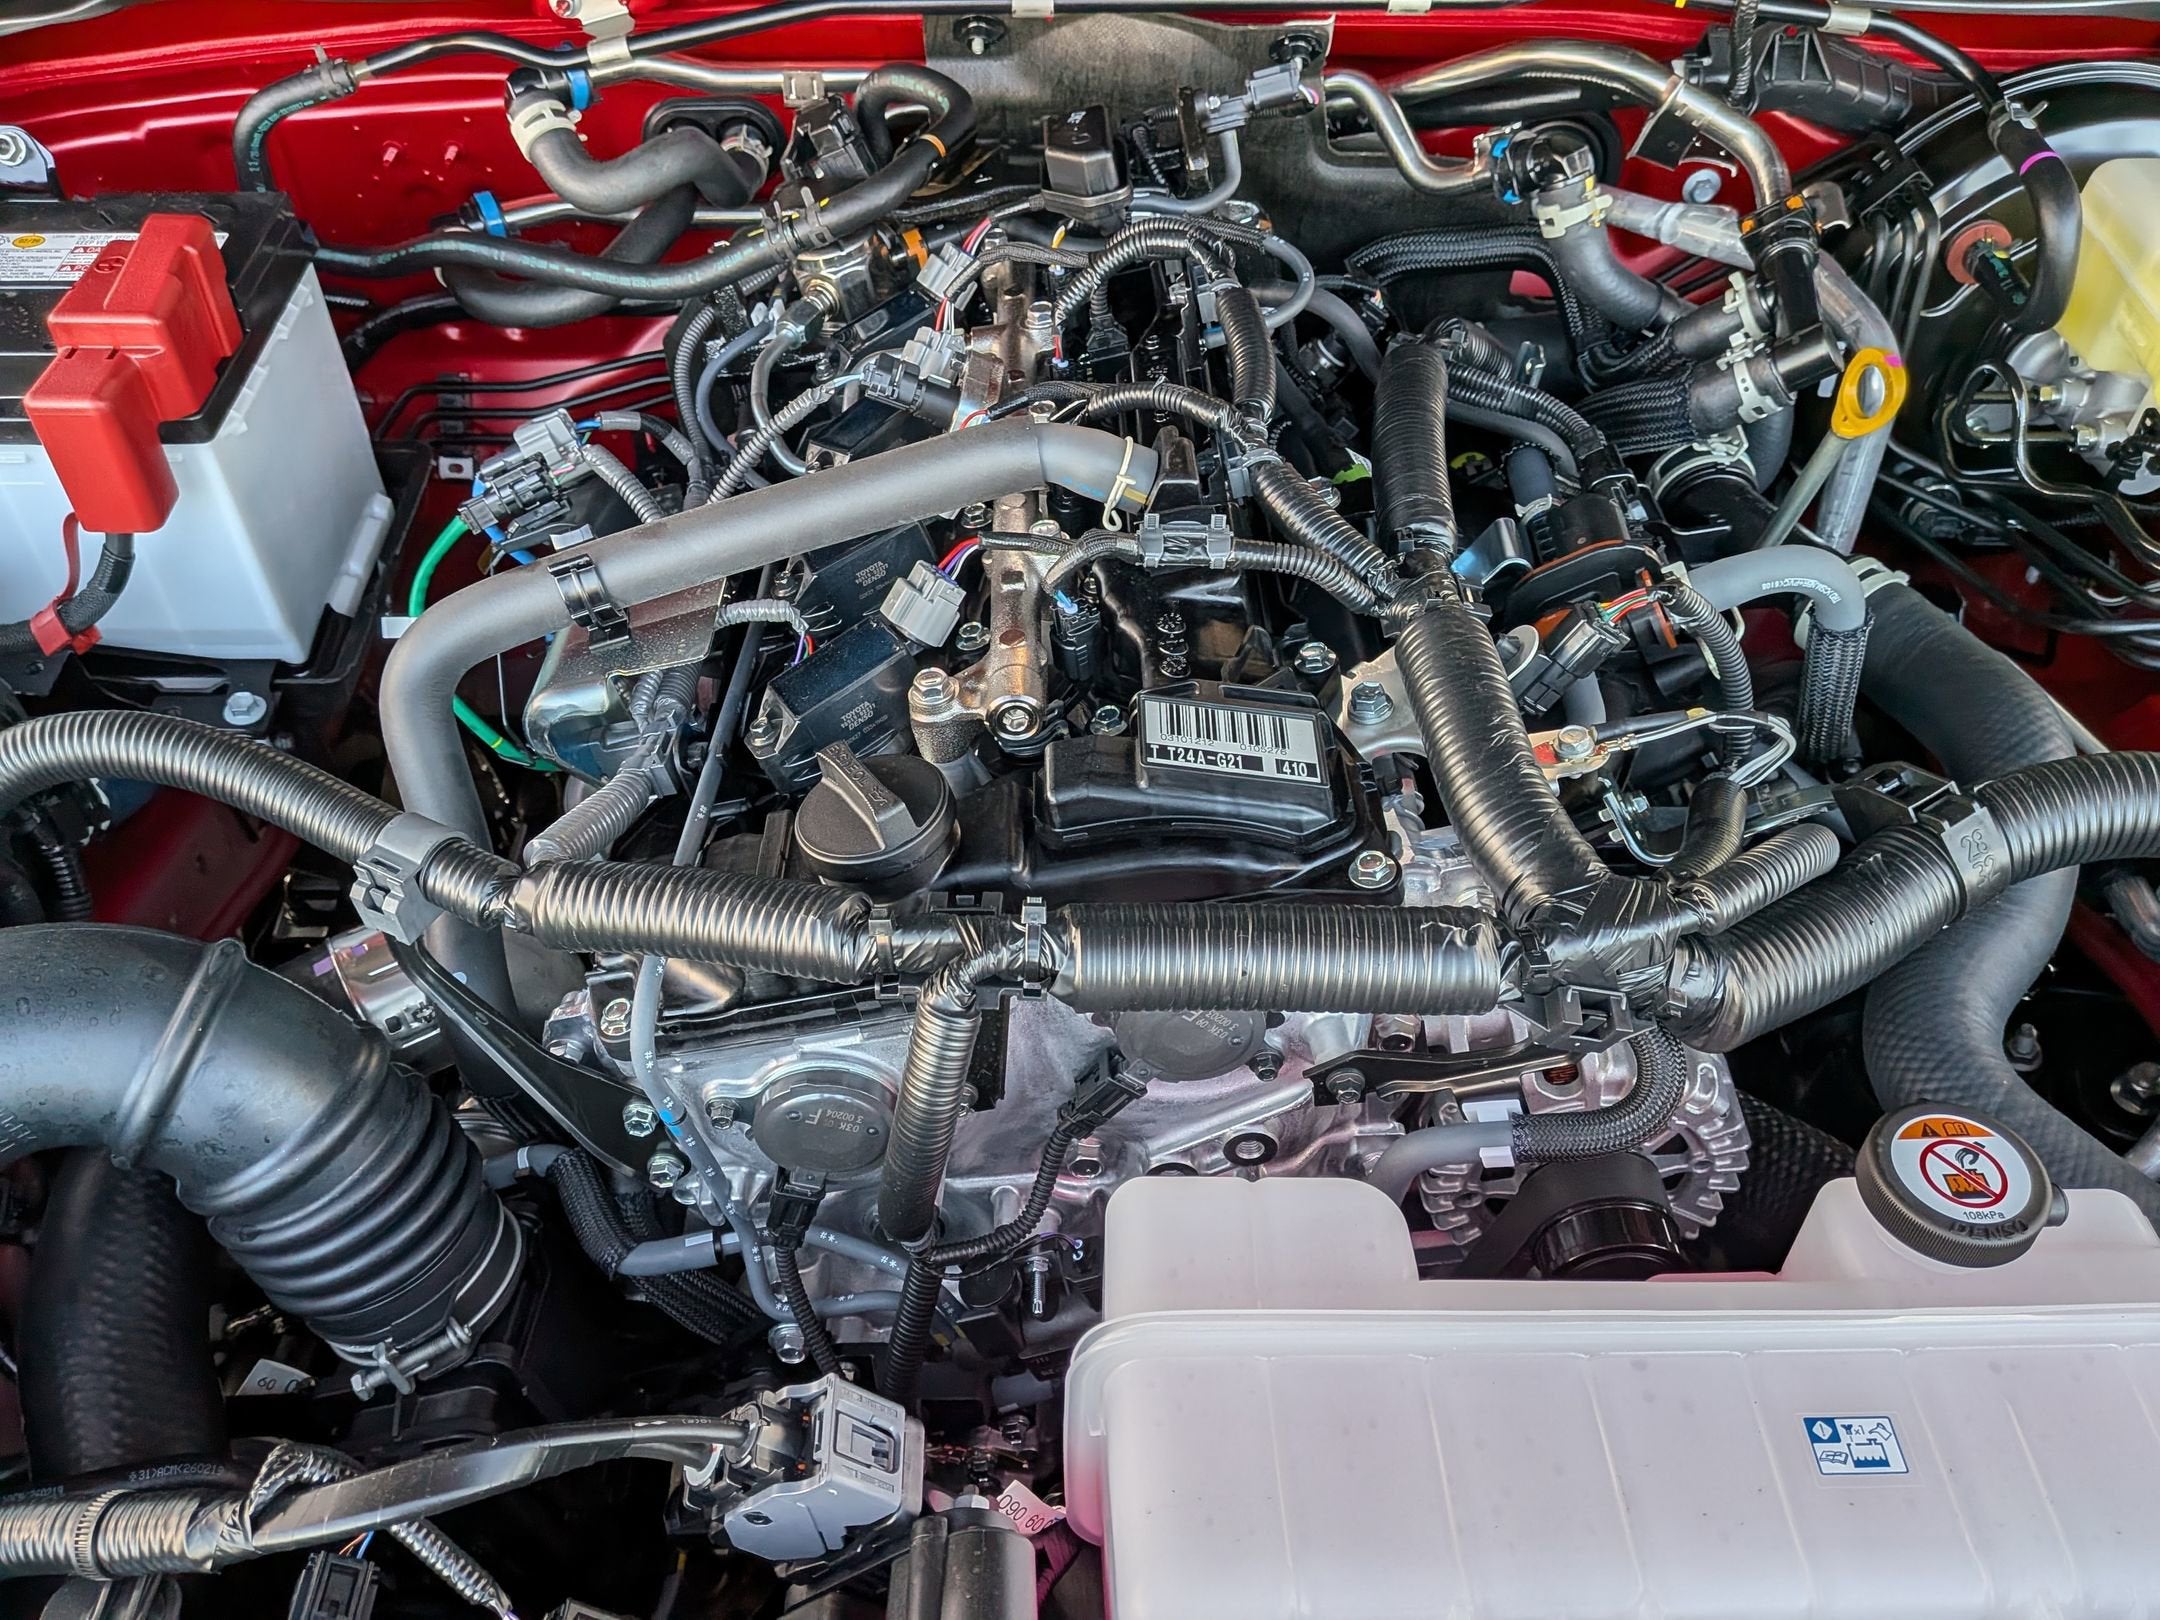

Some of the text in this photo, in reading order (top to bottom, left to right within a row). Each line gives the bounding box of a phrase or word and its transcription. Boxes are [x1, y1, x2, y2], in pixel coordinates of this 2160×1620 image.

[856, 561, 884, 577] TOYOTA
[863, 570, 886, 587] DENSO
[840, 701, 871, 722] TOYOTA
[848, 711, 874, 730] DENSO
[1160, 733, 1215, 747] 03101212
[1151, 745, 1308, 777] T T24A-G21 410
[805, 1108, 822, 1125] F
[1963, 1210, 2006, 1221] 108kPa
[1949, 1220, 2029, 1240] DENSO
[999, 1494, 1028, 1521] 090
